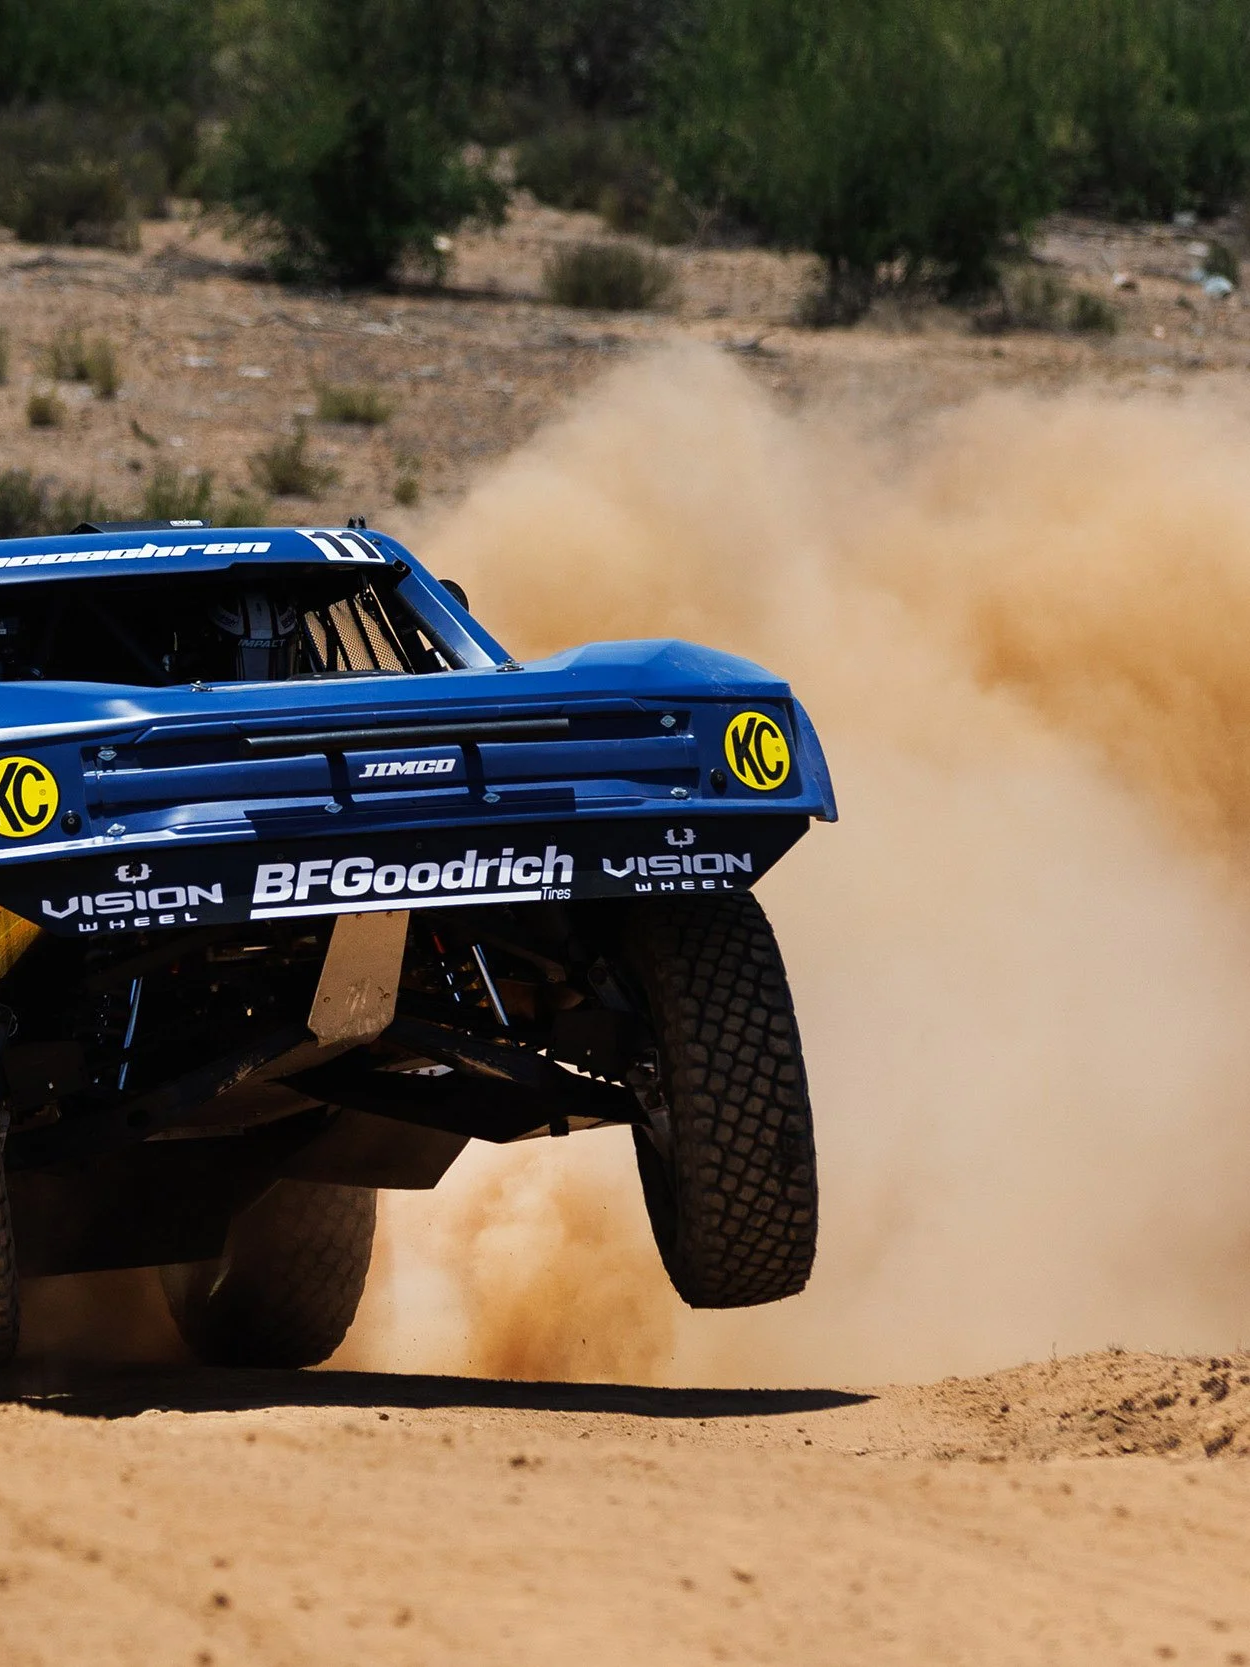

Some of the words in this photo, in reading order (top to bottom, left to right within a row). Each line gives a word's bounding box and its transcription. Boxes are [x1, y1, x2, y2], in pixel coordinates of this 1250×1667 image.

[309, 531, 381, 559] 11
[238, 639, 286, 648] IMPACT
[730, 716, 784, 787] KC
[358, 758, 456, 779] JIMCO
[252, 845, 574, 904] BFGoodrich
[602, 853, 753, 878] VISION
[540, 886, 571, 901] Tires
[635, 880, 734, 892] WHEEL
[42, 883, 224, 919] VISION
[78, 912, 198, 932] WHEEL
